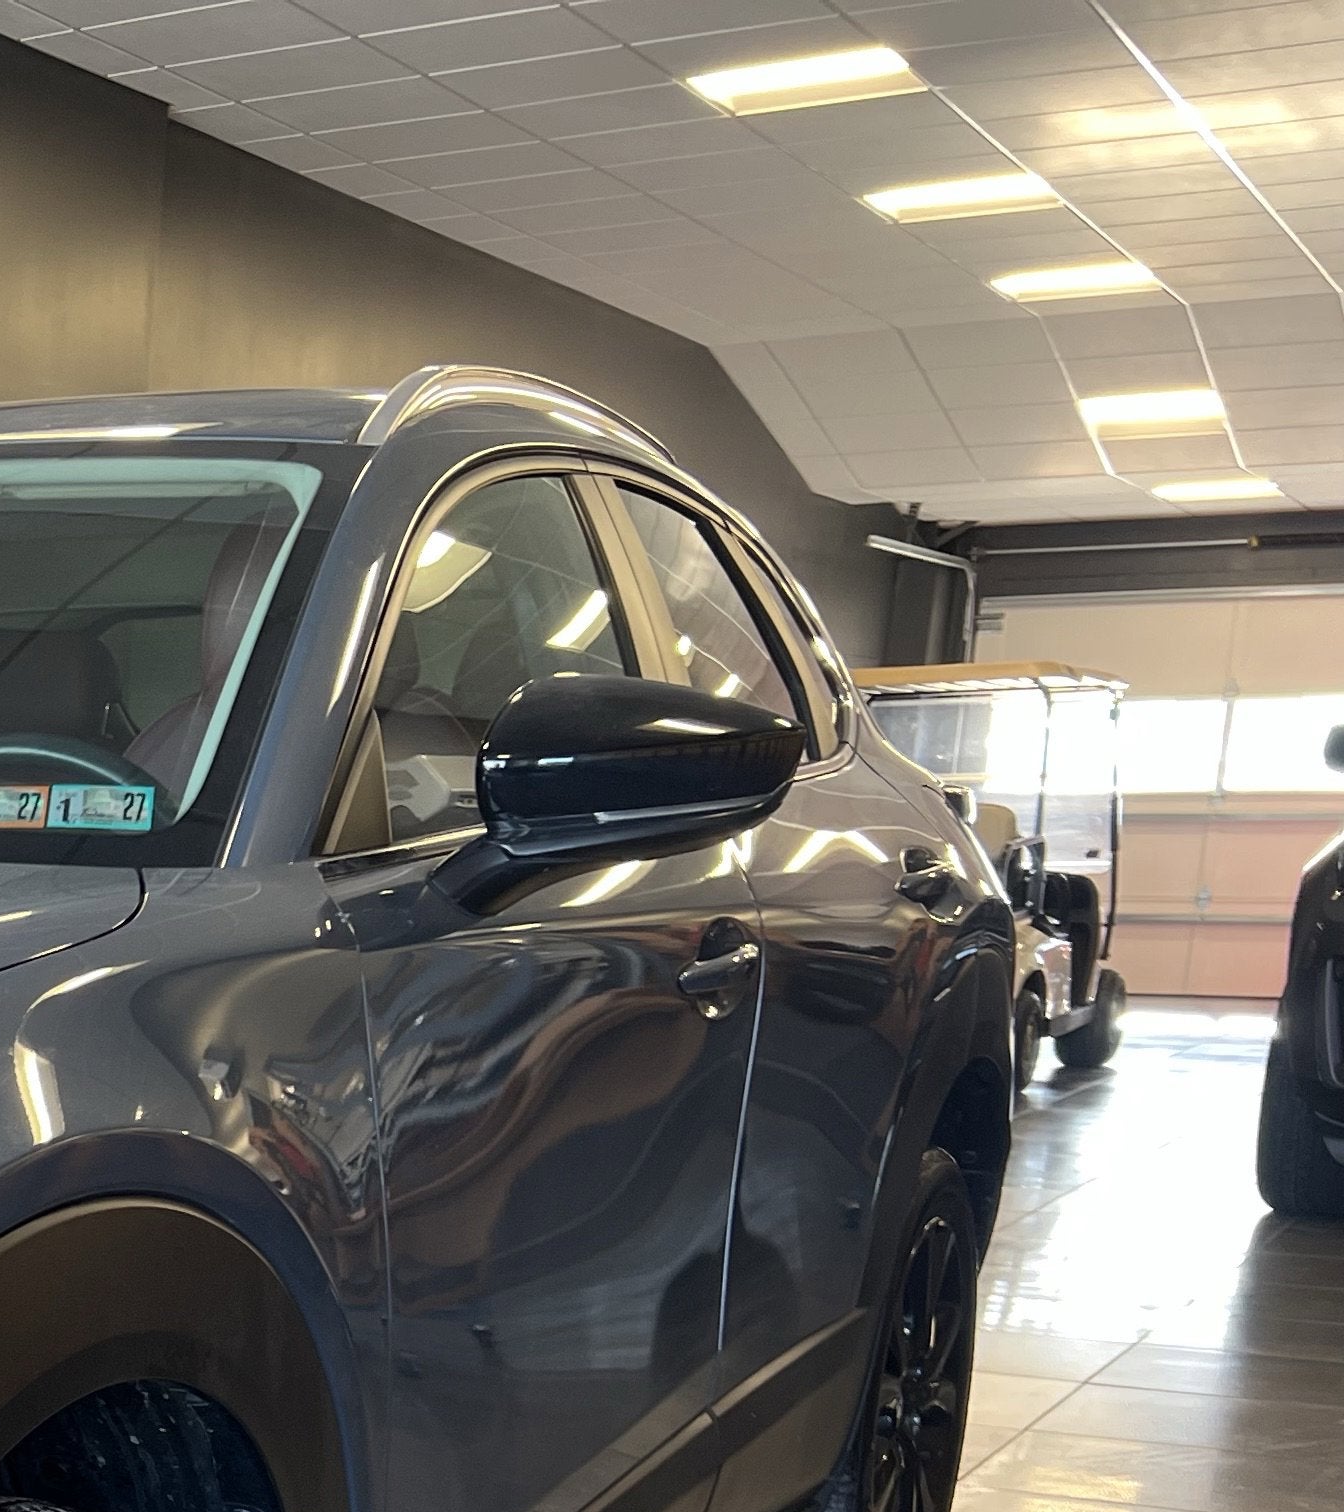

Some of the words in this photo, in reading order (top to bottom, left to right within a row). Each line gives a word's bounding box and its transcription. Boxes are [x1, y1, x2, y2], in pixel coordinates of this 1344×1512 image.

[18, 792, 41, 821] 27
[60, 798, 71, 821] 1
[123, 792, 146, 821] 27
